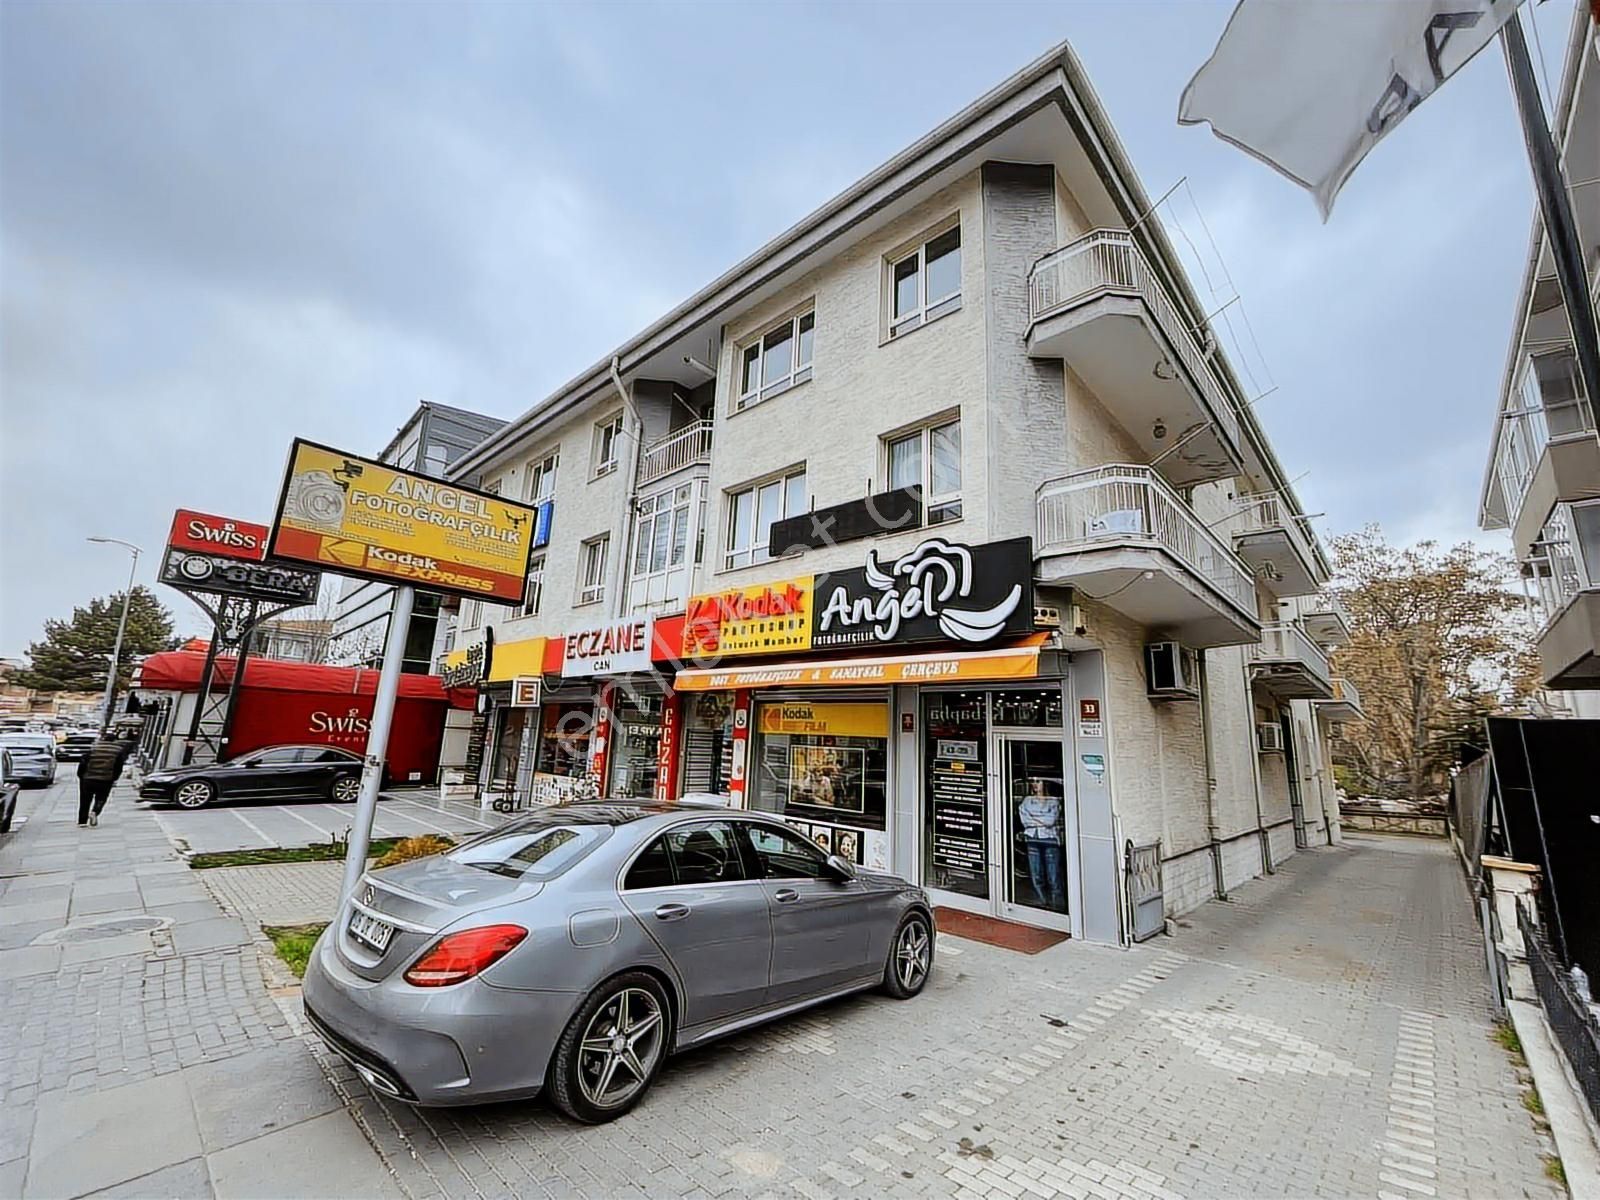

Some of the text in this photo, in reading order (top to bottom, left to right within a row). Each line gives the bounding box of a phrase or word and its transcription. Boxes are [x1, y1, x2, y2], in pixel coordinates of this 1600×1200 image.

[388, 475, 493, 519] ANGEL
[351, 489, 521, 544] FOTOĞRAFÇILIK
[187, 520, 257, 549] Swiss
[367, 545, 438, 570] Kodak
[400, 565, 496, 592] EXPRESS
[720, 584, 804, 622] Kodak
[820, 571, 938, 640] Angel
[566, 624, 645, 660] ECZANE
[593, 660, 610, 671] CAN
[782, 707, 814, 720] Kodak
